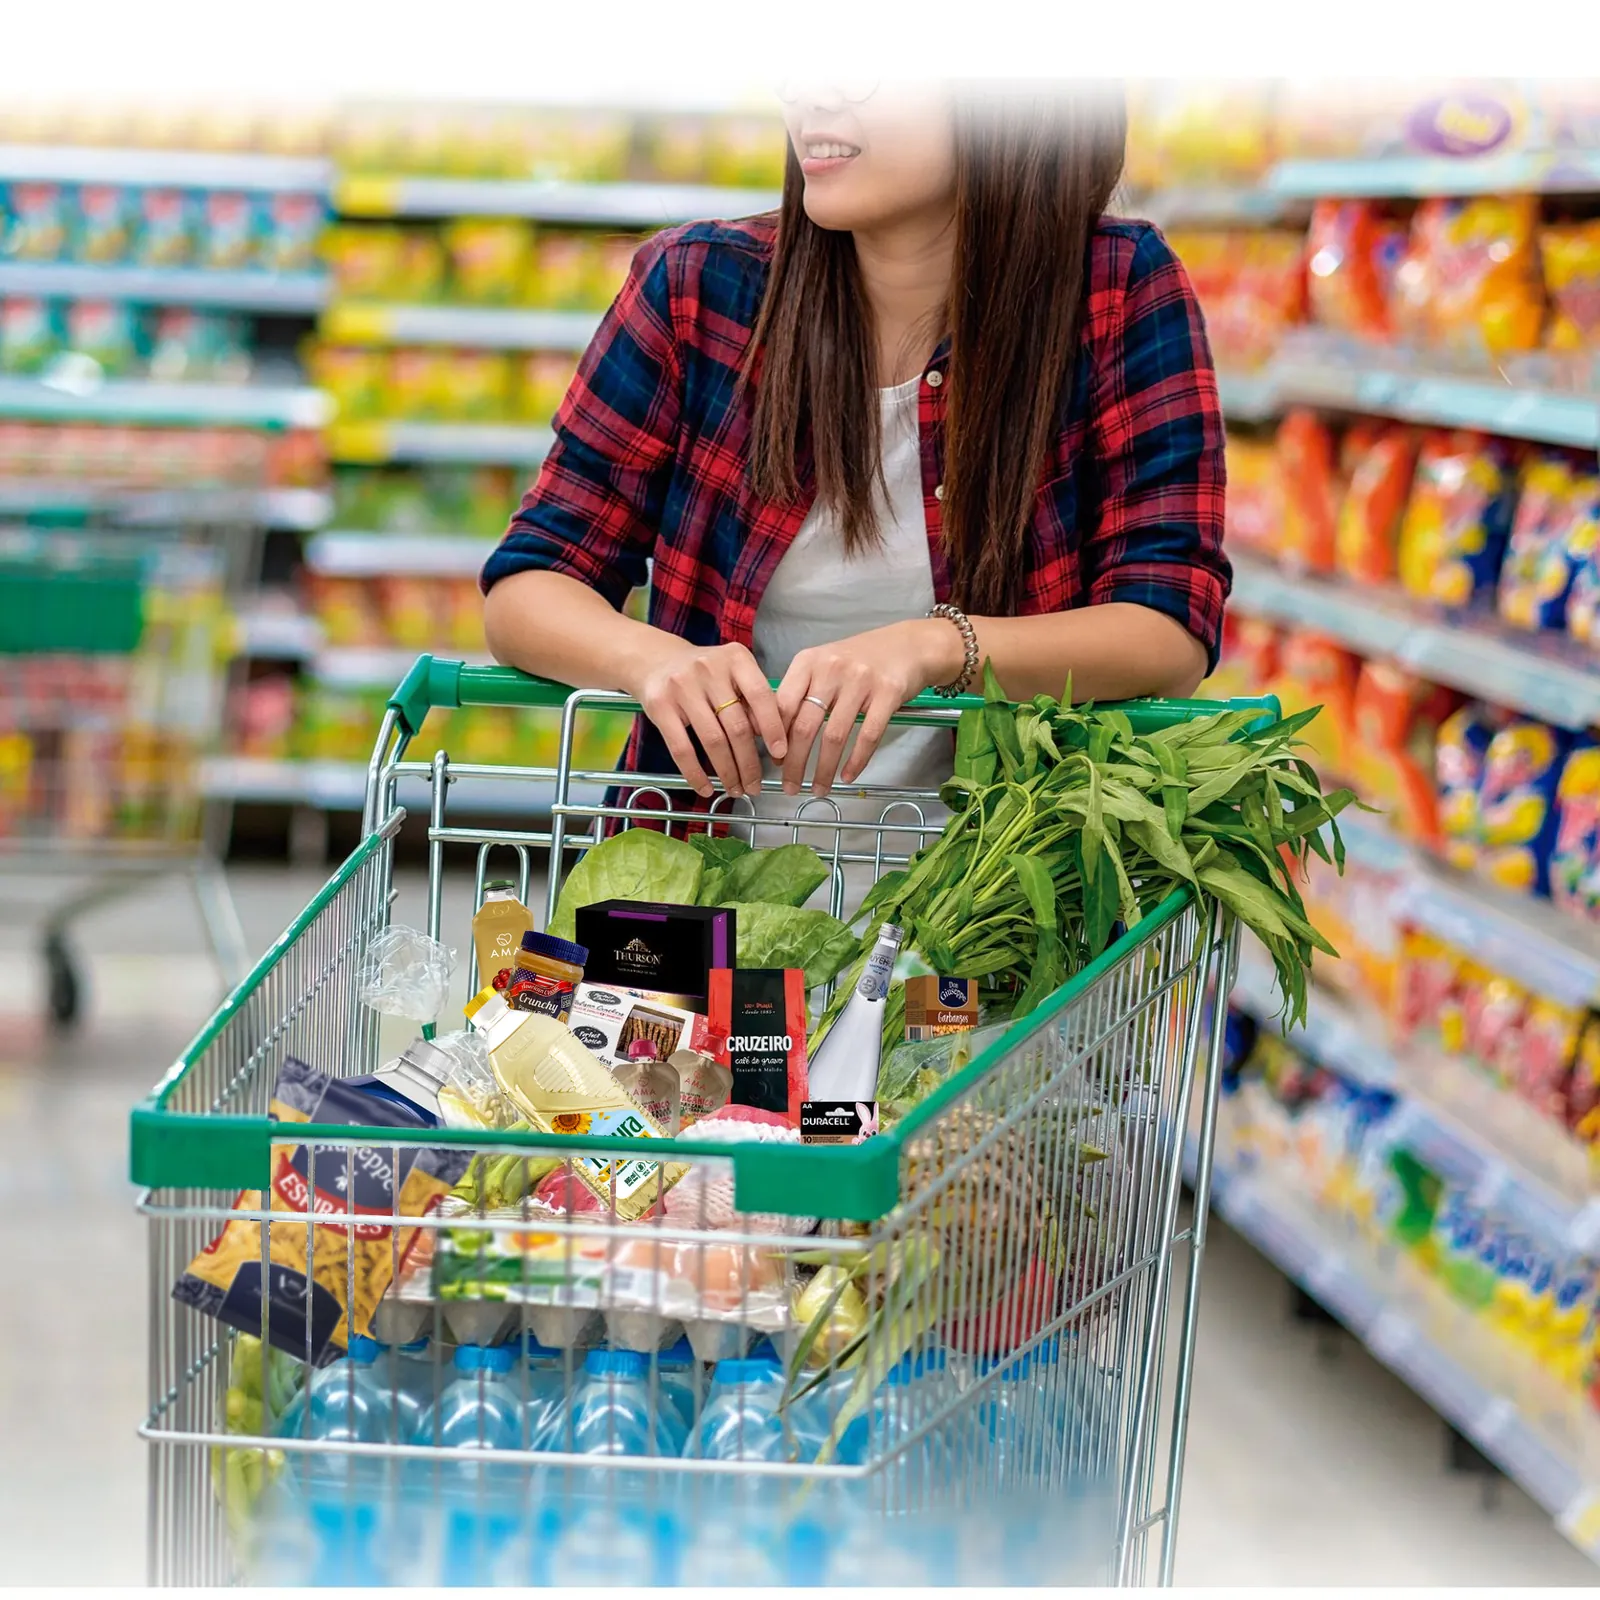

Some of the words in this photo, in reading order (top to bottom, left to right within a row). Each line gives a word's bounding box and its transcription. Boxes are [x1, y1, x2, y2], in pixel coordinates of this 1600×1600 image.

[614, 950, 660, 965] THURSON
[521, 982, 545, 994] American
[948, 981, 959, 989] Don
[940, 988, 967, 1002] Giuseppe
[519, 992, 559, 1014] Crunchy
[937, 1011, 969, 1024] Garbanzos
[579, 1030, 601, 1039] Perfect
[726, 1035, 793, 1052] CRUZEIRO
[735, 1055, 750, 1065] café
[684, 1078, 706, 1091] AMA
[632, 1088, 657, 1097] AMA
[802, 1117, 849, 1126] DURACELL
[803, 1136, 812, 1144] 10
